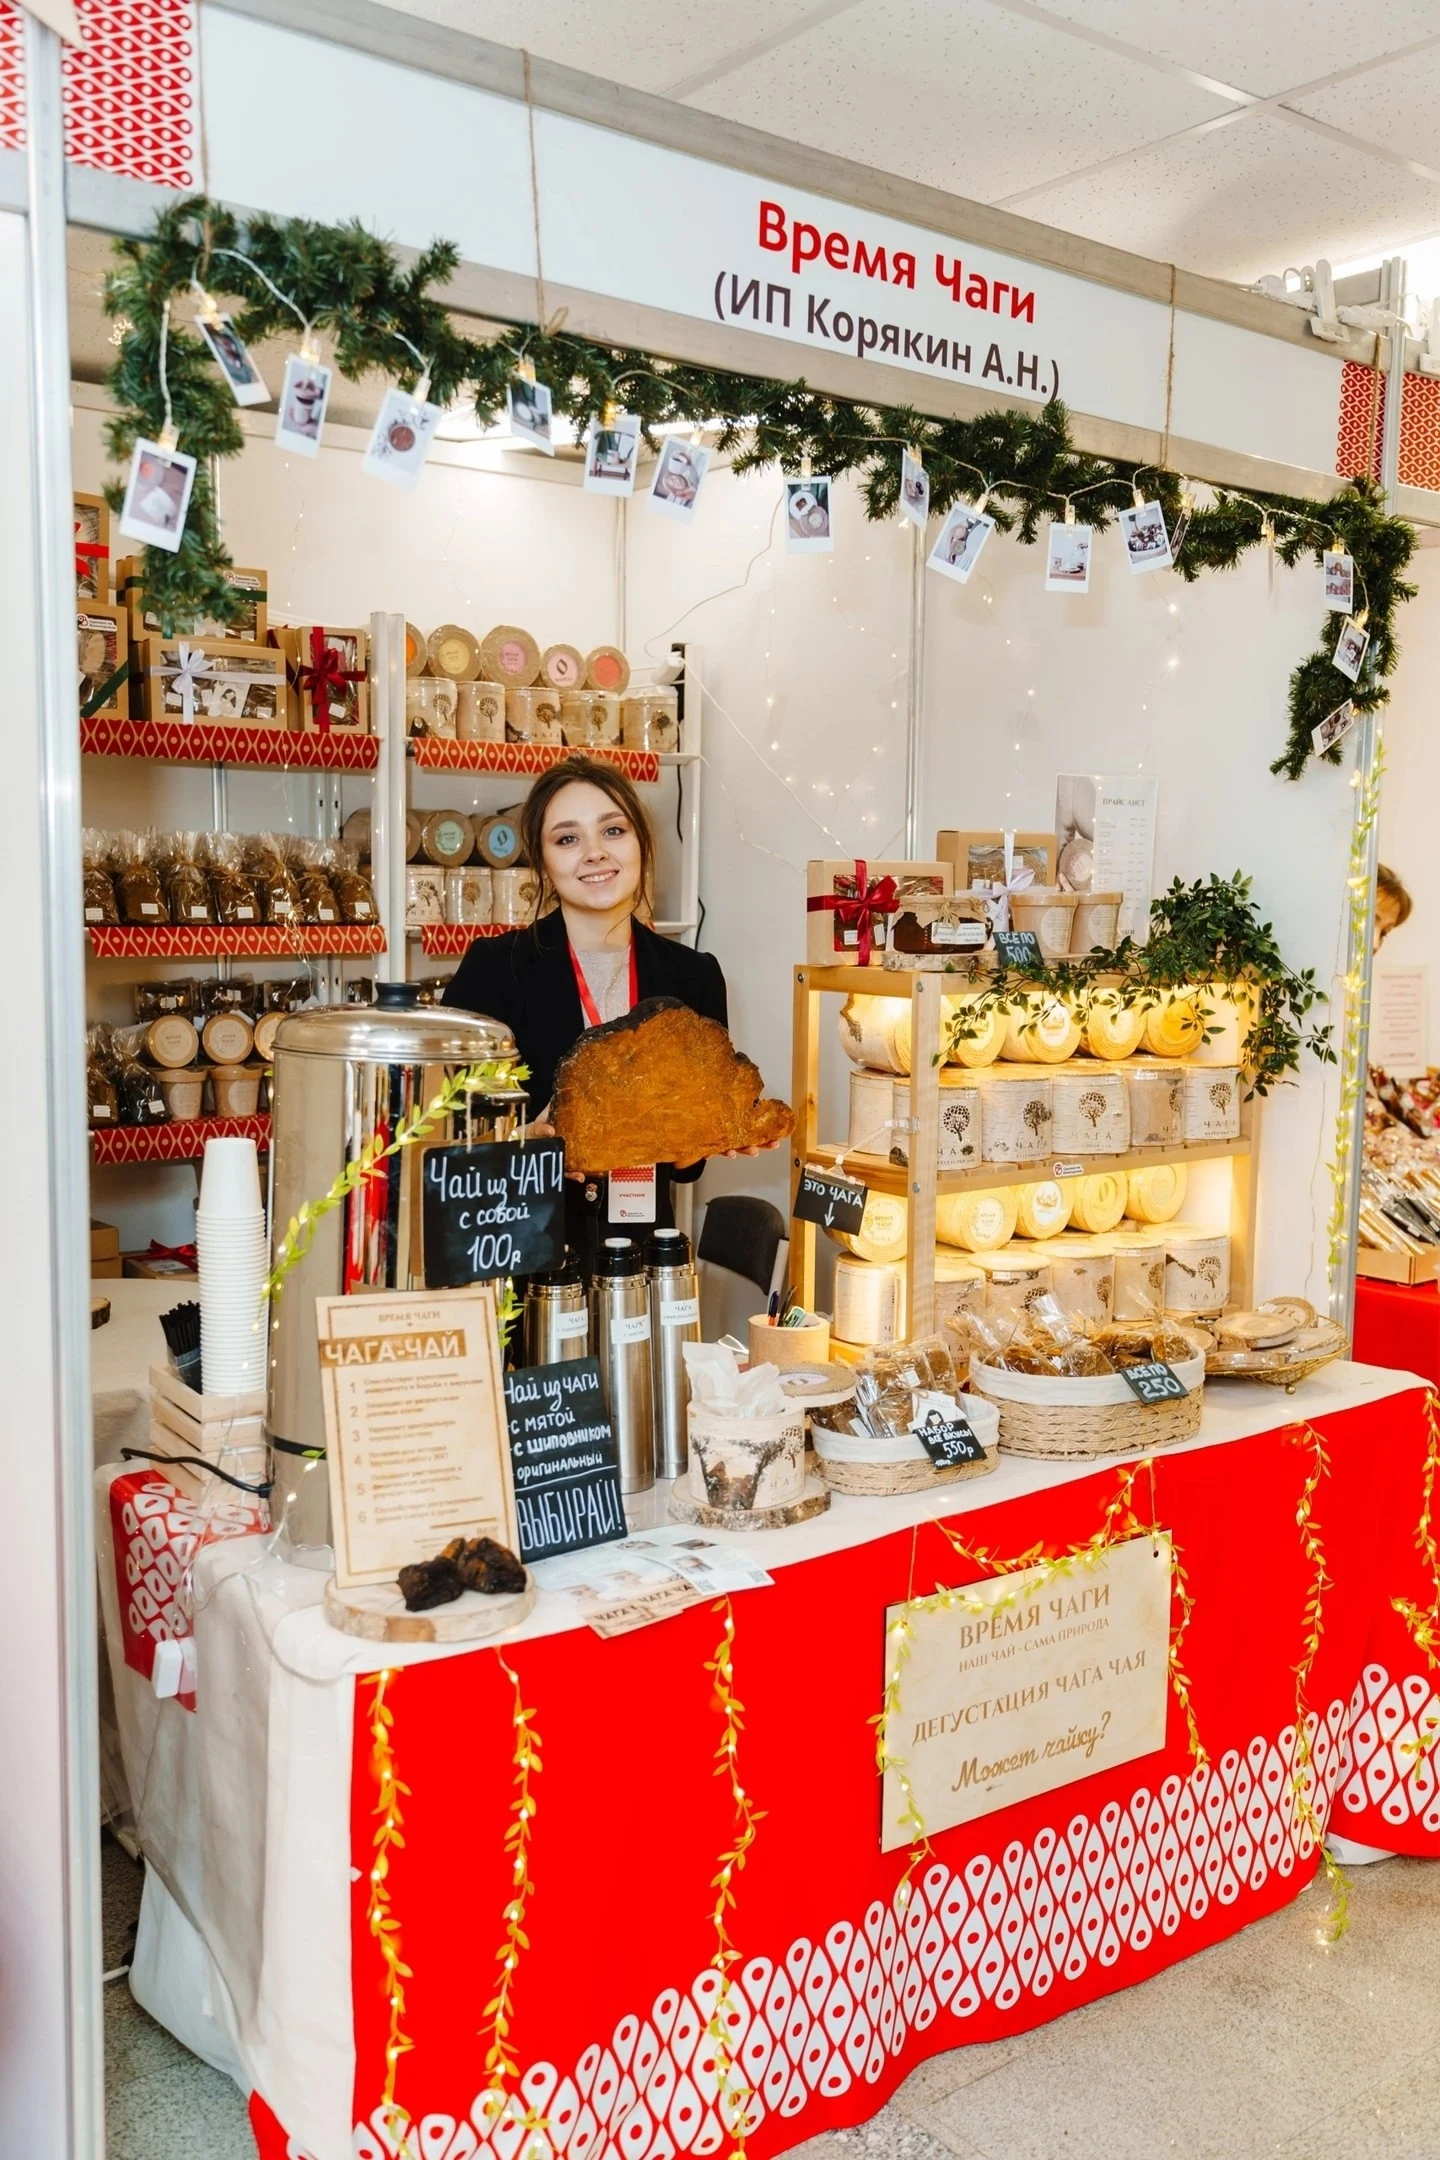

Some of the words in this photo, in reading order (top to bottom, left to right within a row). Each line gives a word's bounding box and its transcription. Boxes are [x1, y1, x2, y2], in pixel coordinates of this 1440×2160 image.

[758, 200, 916, 289] Время
[935, 254, 1035, 324] Чаги
[714, 271, 791, 328] (ИП
[807, 294, 972, 374] Корякин
[982, 343, 1060, 401] А.Н.)
[998, 932, 1020, 944] ВСЕ
[1020, 932, 1036, 945] ПО
[1005, 946, 1031, 964] 500
[430, 1156, 483, 1202] Чай
[486, 1178, 508, 1209] из
[510, 1151, 564, 1196] ЧАГИ
[803, 1179, 826, 1196] ЭТО
[829, 1186, 863, 1208] ЧАГА
[459, 1211, 472, 1229] с
[476, 1202, 531, 1224] собой
[378, 1313, 411, 1323] ВРЕМЯ
[414, 1311, 441, 1320] ЧАГИ
[325, 1331, 460, 1366] ЧАГА-ЧАЙ
[1125, 1365, 1151, 1380] ВСЕ
[1147, 1363, 1168, 1377] ПО
[349, 1382, 356, 1394] 1
[543, 1379, 563, 1412] из
[563, 1373, 600, 1395] ЧАГИ
[1138, 1376, 1180, 1399] 250
[350, 1406, 359, 1418] 2
[510, 1419, 520, 1434] с
[525, 1407, 575, 1432] мятой
[352, 1430, 361, 1442] 3
[513, 1442, 524, 1457] с
[526, 1424, 612, 1454] шиповником
[918, 1422, 954, 1437] НАБОР
[928, 1434, 943, 1445] ВСЕ
[943, 1429, 973, 1441] ВКУСЫ
[353, 1454, 362, 1466] 4
[516, 1451, 603, 1485] оригинальный
[356, 1483, 365, 1496] 5
[358, 1511, 367, 1523] 6
[516, 1479, 623, 1551] ВЫБИРАЙ!
[959, 1604, 1041, 1650] ВРЕМЯ
[1049, 1583, 1111, 1621] ЧАГИ
[959, 1653, 988, 1673] НАШ
[991, 1644, 1016, 1664] ЧАЙ
[1024, 1637, 1056, 1653] САМА
[1058, 1617, 1110, 1646] ПРИРОДА
[912, 1682, 1050, 1746] ДЕГУСТАЦИЯ
[1056, 1664, 1104, 1693] ЧАГА
[1108, 1649, 1147, 1677] ЧАЯ
[951, 1746, 1039, 1792] Может
[1041, 1710, 1113, 1759] чайку?
